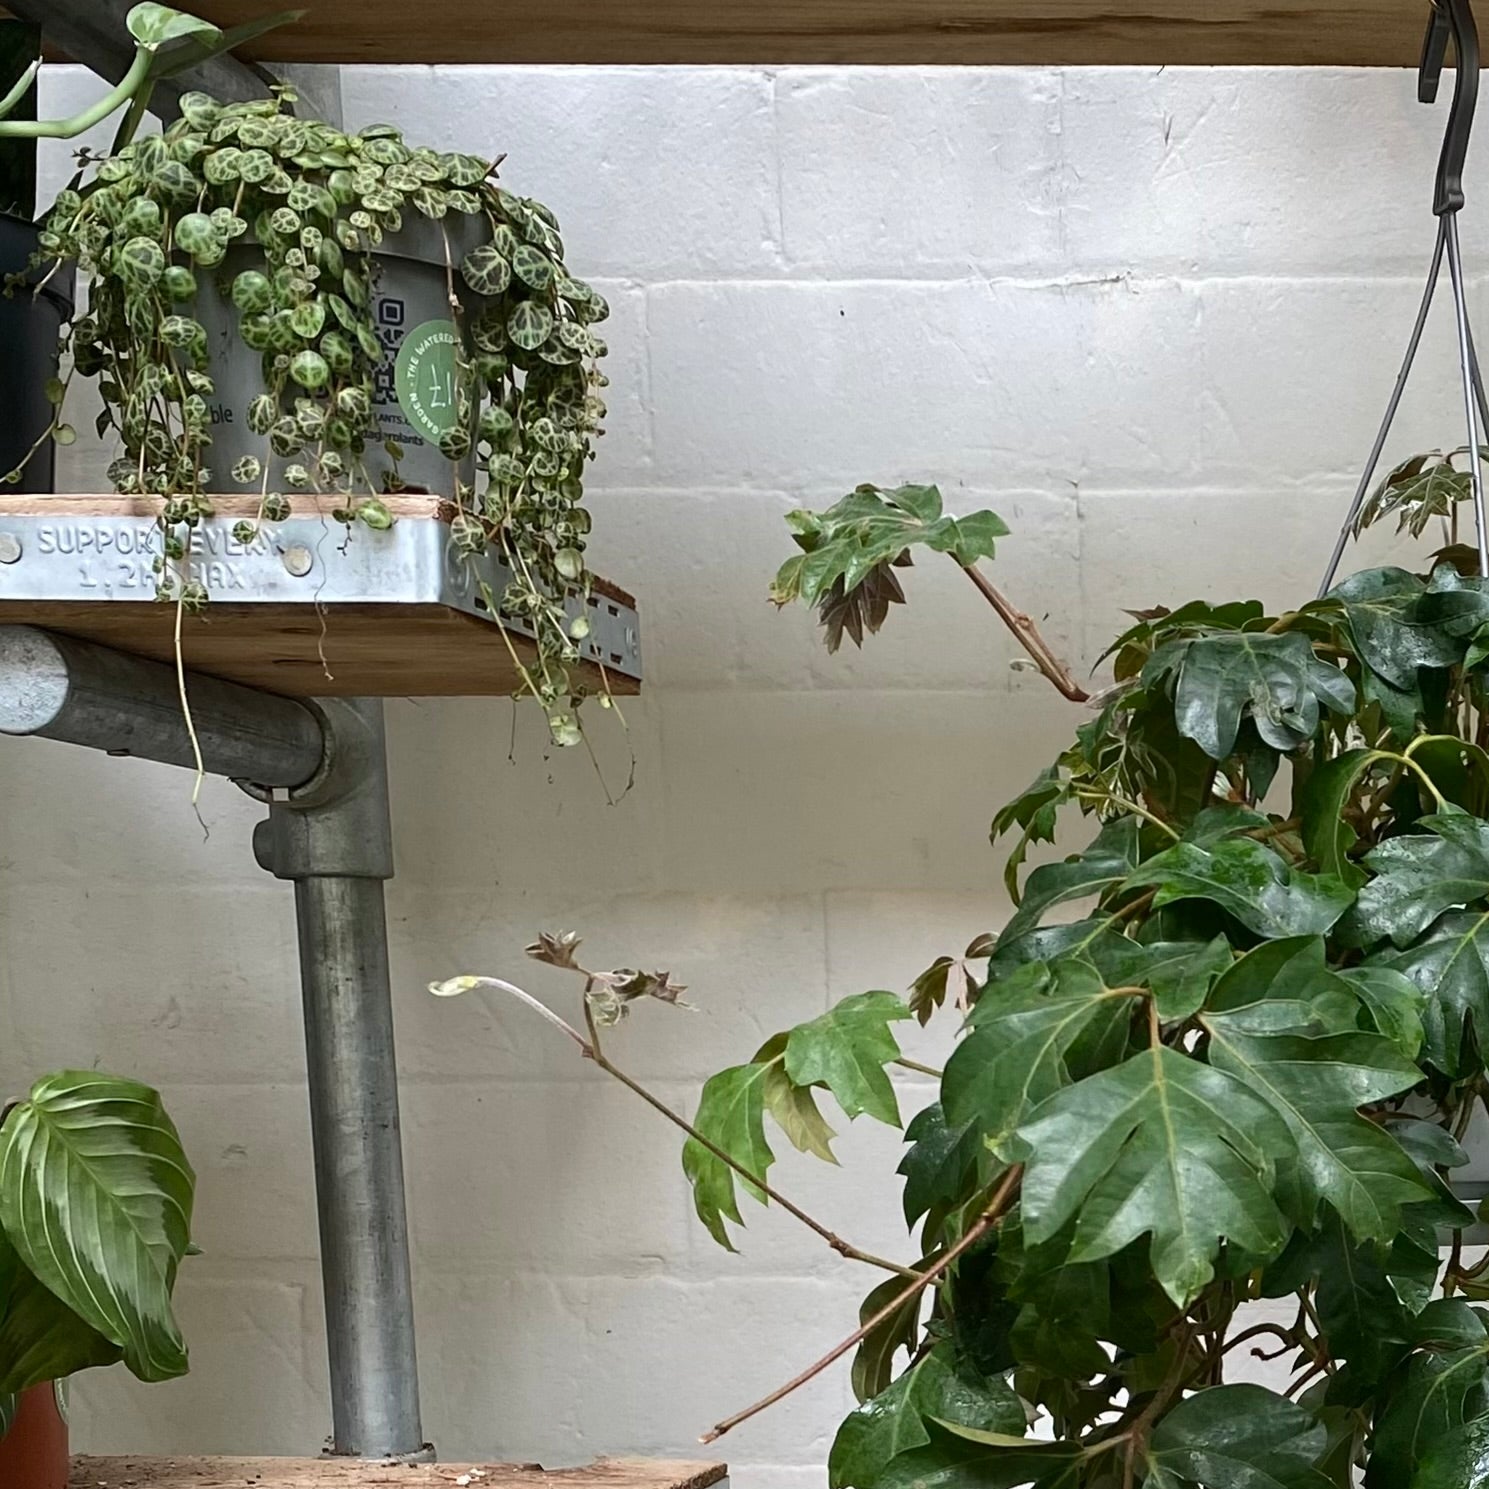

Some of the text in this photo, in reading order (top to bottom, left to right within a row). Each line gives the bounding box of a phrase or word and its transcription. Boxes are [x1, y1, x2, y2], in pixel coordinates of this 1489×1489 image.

[407, 333, 454, 434] GARDEN THE WATERED
